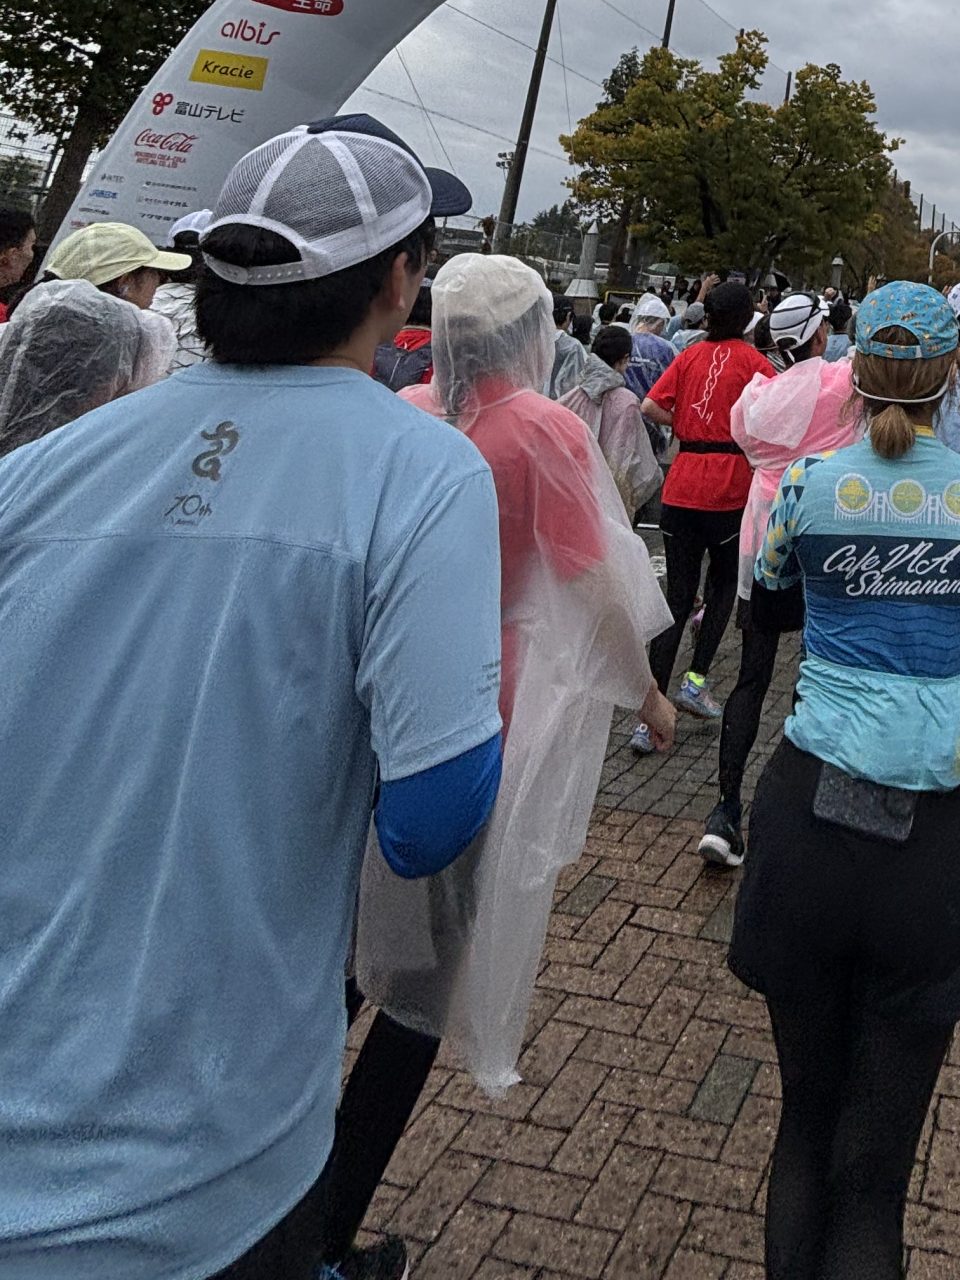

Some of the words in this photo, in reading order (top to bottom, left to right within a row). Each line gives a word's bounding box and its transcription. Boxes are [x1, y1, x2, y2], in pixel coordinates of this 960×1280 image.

[220, 19, 281, 46] albis
[201, 60, 255, 79] Kracie
[174, 101, 247, 123] 富山テレビ
[823, 543, 880, 580] Cafe
